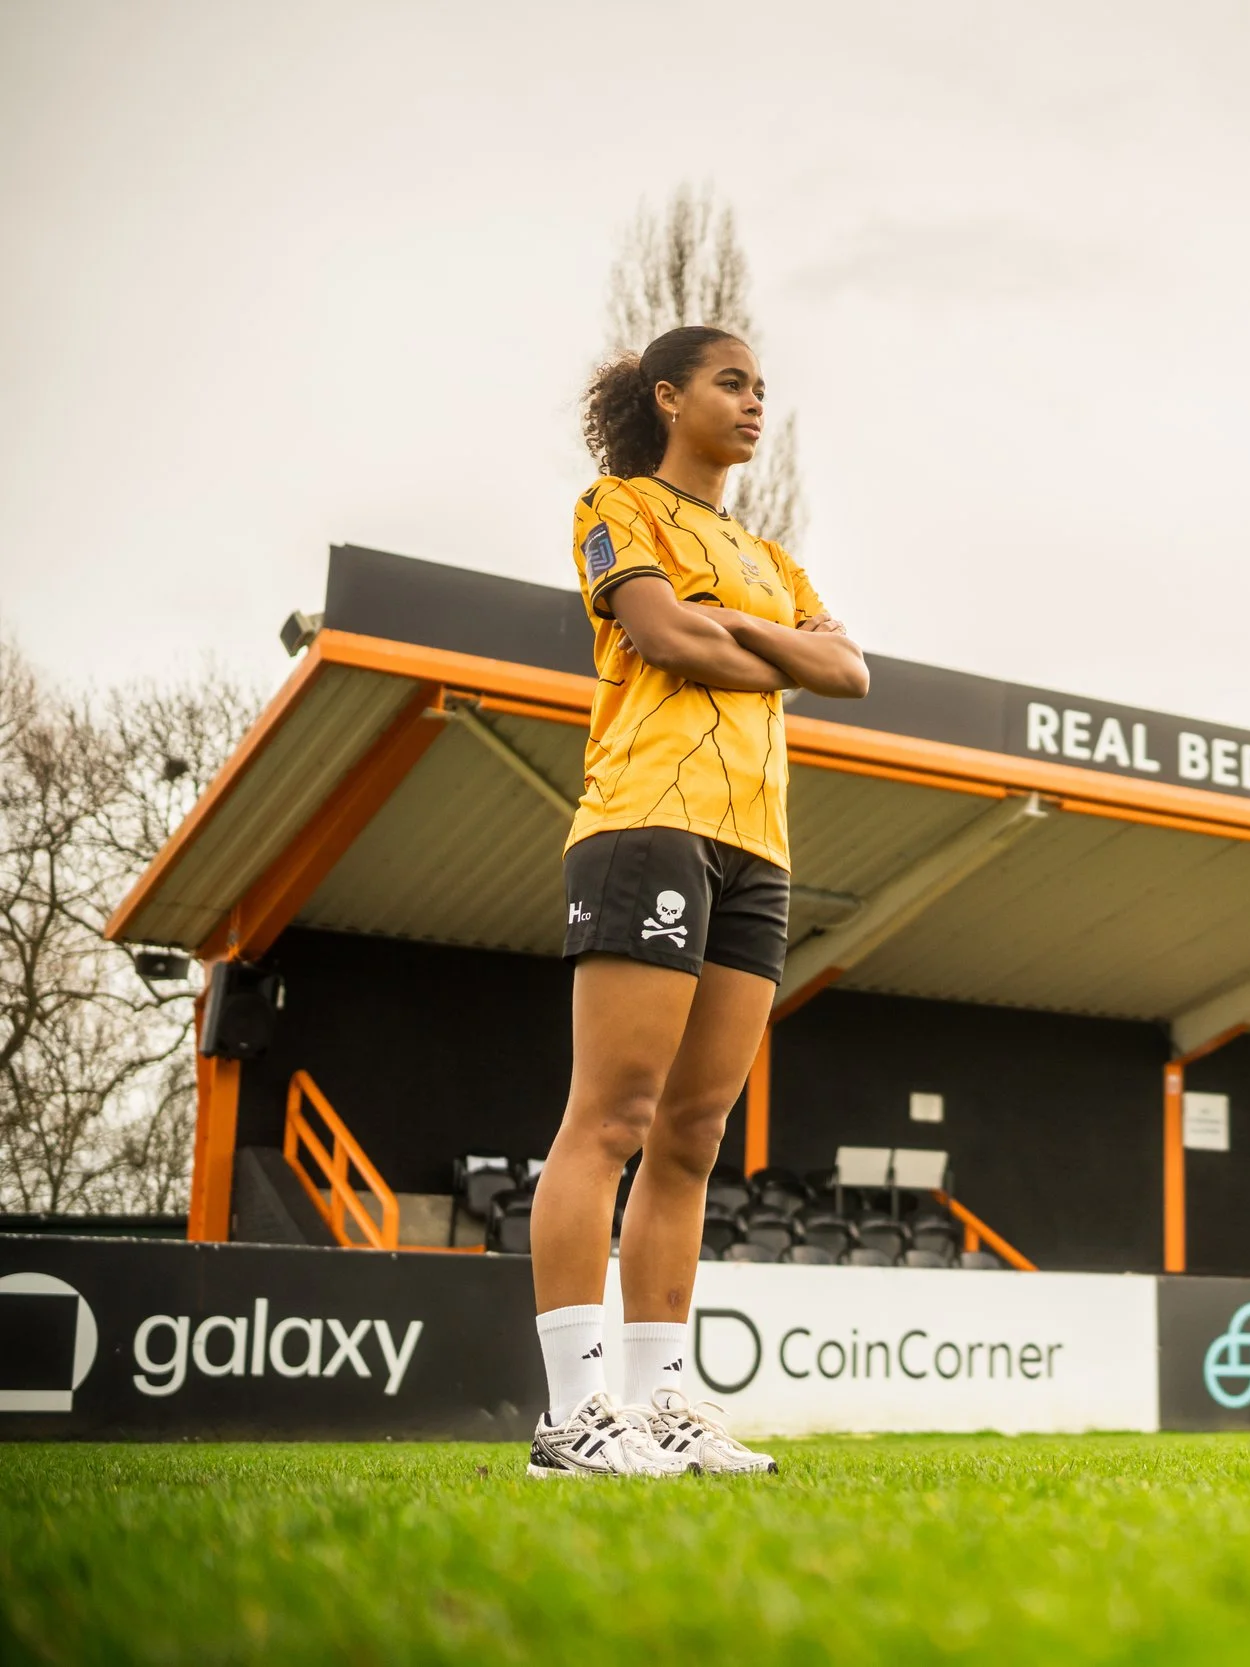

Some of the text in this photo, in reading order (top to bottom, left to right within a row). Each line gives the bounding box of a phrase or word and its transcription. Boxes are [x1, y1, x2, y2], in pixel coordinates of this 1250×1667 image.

[1026, 702, 1161, 773] REAL
[133, 1297, 424, 1396] galaxy
[779, 1327, 1064, 1380] CoinCorner
